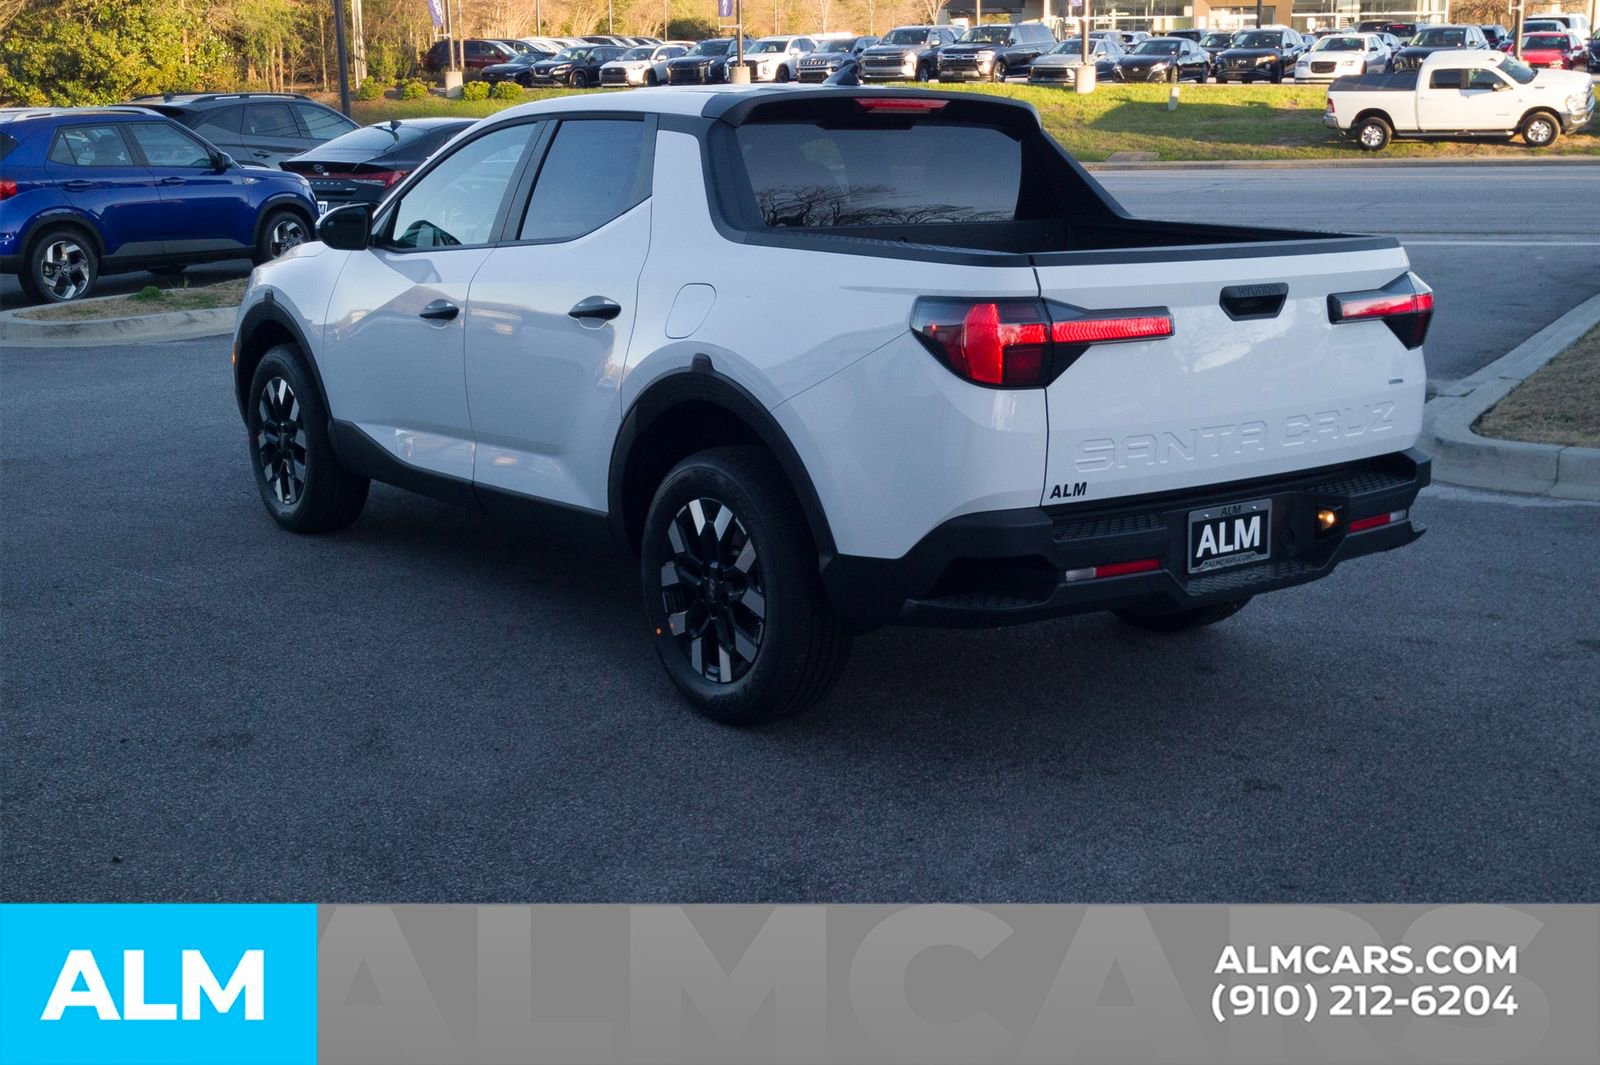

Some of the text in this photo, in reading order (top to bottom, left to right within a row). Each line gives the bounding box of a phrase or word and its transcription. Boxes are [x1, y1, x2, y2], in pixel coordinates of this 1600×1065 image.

[1074, 400, 1395, 473] SANTA CRUZ
[1049, 482, 1088, 500] ALM
[1220, 504, 1242, 517] ALM
[1195, 515, 1261, 558] ALM
